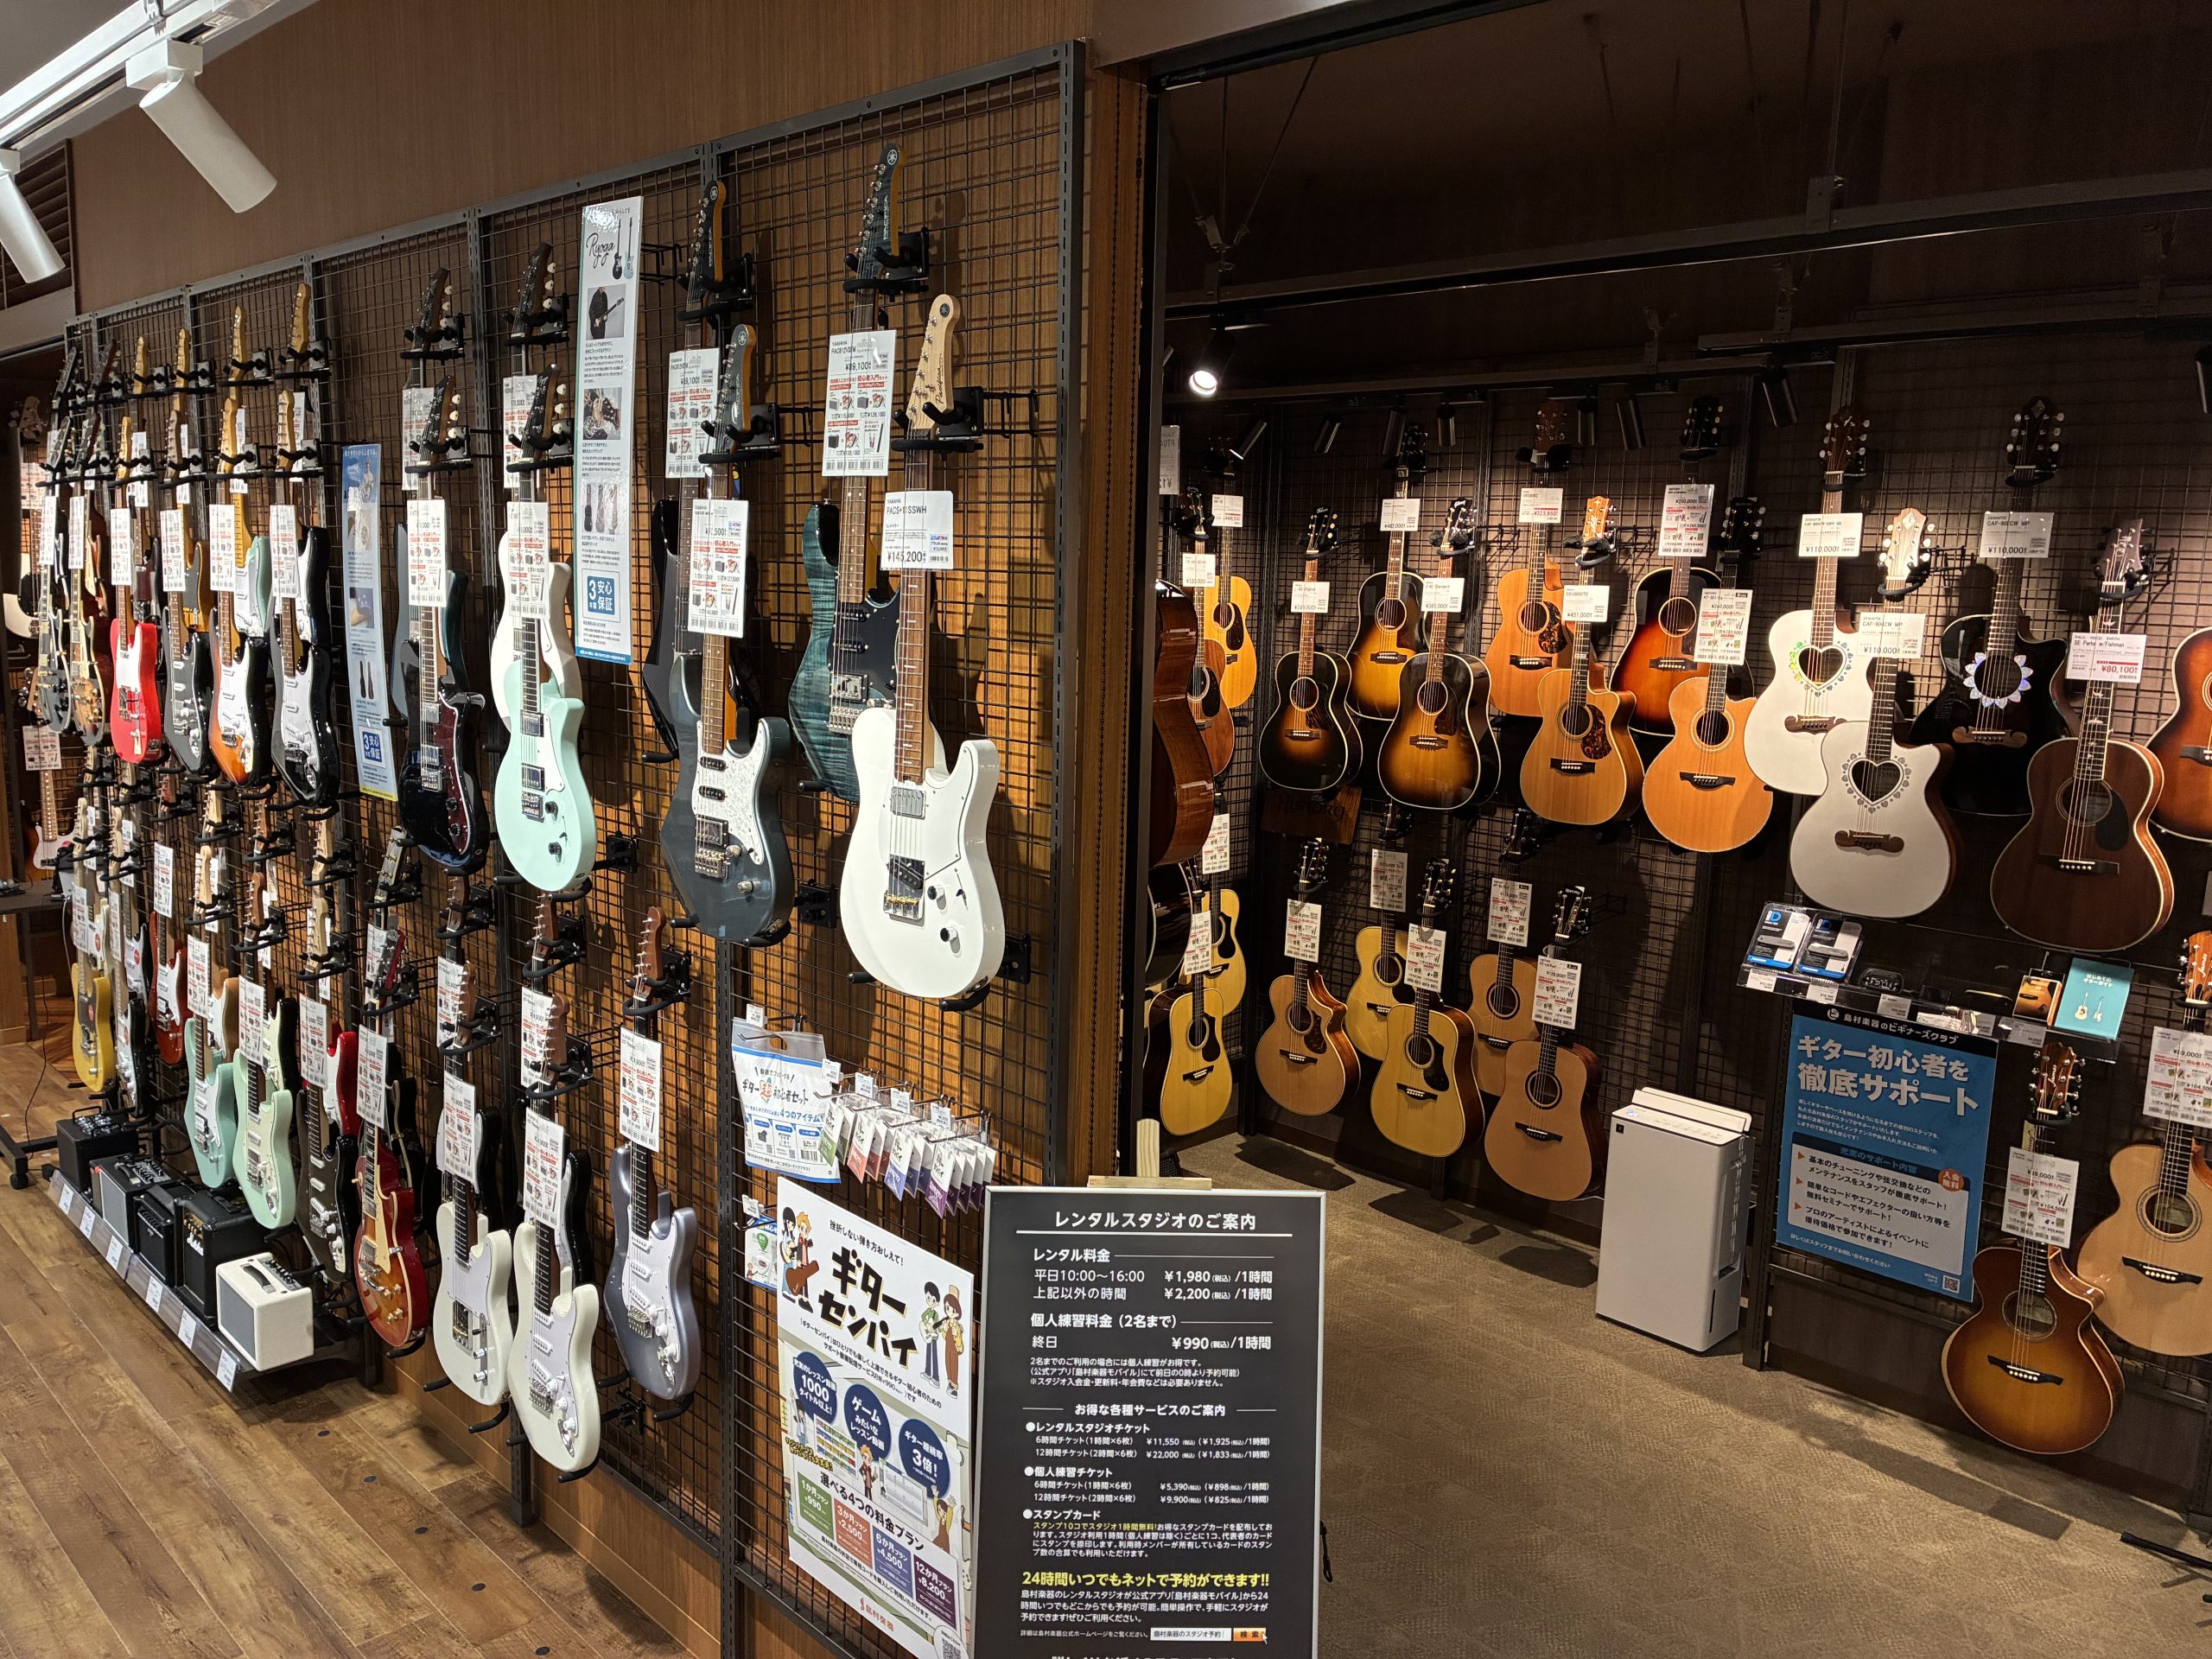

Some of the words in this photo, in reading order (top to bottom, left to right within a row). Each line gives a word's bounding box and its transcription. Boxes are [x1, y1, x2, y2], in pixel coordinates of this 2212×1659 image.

[587, 232, 614, 269] Ryoga
[887, 551, 922, 563] ¥145,200
[598, 581, 612, 594] 安心
[598, 596, 613, 611] 保証
[369, 735, 378, 747] 安心
[370, 747, 380, 760] 保証
[2082, 977, 2113, 988] ギターガイド
[1844, 1014, 1959, 1044] 島村楽器のビギナーズクラブ
[1797, 1035, 1969, 1082] ギター初心者を
[1797, 1062, 1979, 1117] 徹底サポート
[1808, 1156, 1931, 1195] 基本のチューニングや弦交換などの
[1808, 1166, 1948, 1211] メンテナンスをスタッフが徹底サポート!
[1807, 1181, 1950, 1229] 簡単なコードやエフェクターの扱い方等を
[1807, 1191, 1891, 1222] 無料セミナーでサポート!
[1055, 1211, 1256, 1230] レンタルスタジオのご案内
[1805, 1206, 1929, 1249] プロのアーティストによるイベントに
[1805, 1217, 1892, 1249] 優待価格で参加できます!
[830, 1219, 904, 1266] 挫折しない弾き方おしえて!
[1033, 1248, 1110, 1263] レンタル料金
[831, 1246, 906, 1315] ギター
[1034, 1268, 1145, 1282] 平日10:00〜16:00
[1033, 1287, 1127, 1300] 上記以外の時間
[818, 1289, 918, 1365] センパイ
[1030, 1313, 1113, 1327] 個人練習料金
[1118, 1313, 1177, 1329] (2名まで)
[1032, 1336, 1058, 1349] 終日
[1030, 1357, 1203, 1368] 2名までのご利用の場合には個人練習がお得です。
[1030, 1367, 1240, 1378] (公式アプリ「島村楽器モバイル」にて前日の0時より予約可能)
[801, 1374, 830, 1402] 1000
[1030, 1377, 1224, 1388] ※スタジオ入会金・更新料・年会費などは必要ありません。
[799, 1389, 833, 1415] タイトル以上!
[852, 1395, 881, 1426] ゲーム
[1074, 1404, 1226, 1417] お得な各種サービスのご案内
[855, 1414, 879, 1435] みたいな
[1036, 1422, 1150, 1433] レンタルスタジオチケット
[850, 1421, 885, 1451] レッスン動画
[1036, 1436, 1134, 1446] 6時間チケット(1時間×6枚)
[904, 1430, 944, 1460] ギター継続率
[1035, 1448, 1137, 1459] 12時間チケット(2時間×6枚)
[912, 1449, 938, 1478] 3倍!
[1034, 1466, 1113, 1478] 個人練習チケット
[801, 1480, 829, 1504] 1か月プラン
[1034, 1481, 1132, 1491] 6時間チケット(1時間×6枚)
[804, 1495, 822, 1511] ¥990
[1033, 1493, 1136, 1503] 12時間チケット(2時間×6枚)
[820, 1471, 925, 1551] 選べる4つの料金プラン
[1033, 1510, 1101, 1520] スタンプカード
[837, 1508, 868, 1533] 3か月プラン
[1033, 1522, 1273, 1531] スタンプ10コでスタジオ1時間無料!お得なスタンプカードを配布してお
[838, 1521, 862, 1541] ¥2,500
[876, 1534, 907, 1562] 6か月プラン
[1033, 1548, 1149, 1558] プ数の合算でも利用いただけます。
[877, 1548, 903, 1570] ¥4,500
[915, 1560, 952, 1592] 12か月プラン
[1021, 1572, 1269, 1588] 24時間いつでもネットで予約ができます!!
[918, 1577, 945, 1600] ¥8,200
[1021, 1590, 1268, 1601] 島村楽器のレンタルスタジオが公式アプリ「島村楽器モバイル」から24
[1020, 1601, 1268, 1612] 時間いつでもどこからでも予約が可能。簡単操作で、手軽にスタジオが
[866, 1604, 894, 1631] 島村楽器
[1020, 1613, 1142, 1624] 予約できます!ぜひご利用ください。
[1020, 1630, 1148, 1638] 詳細は島村楽器公式ホームページをご覧ください。
[1240, 1630, 1259, 1639] 検索
